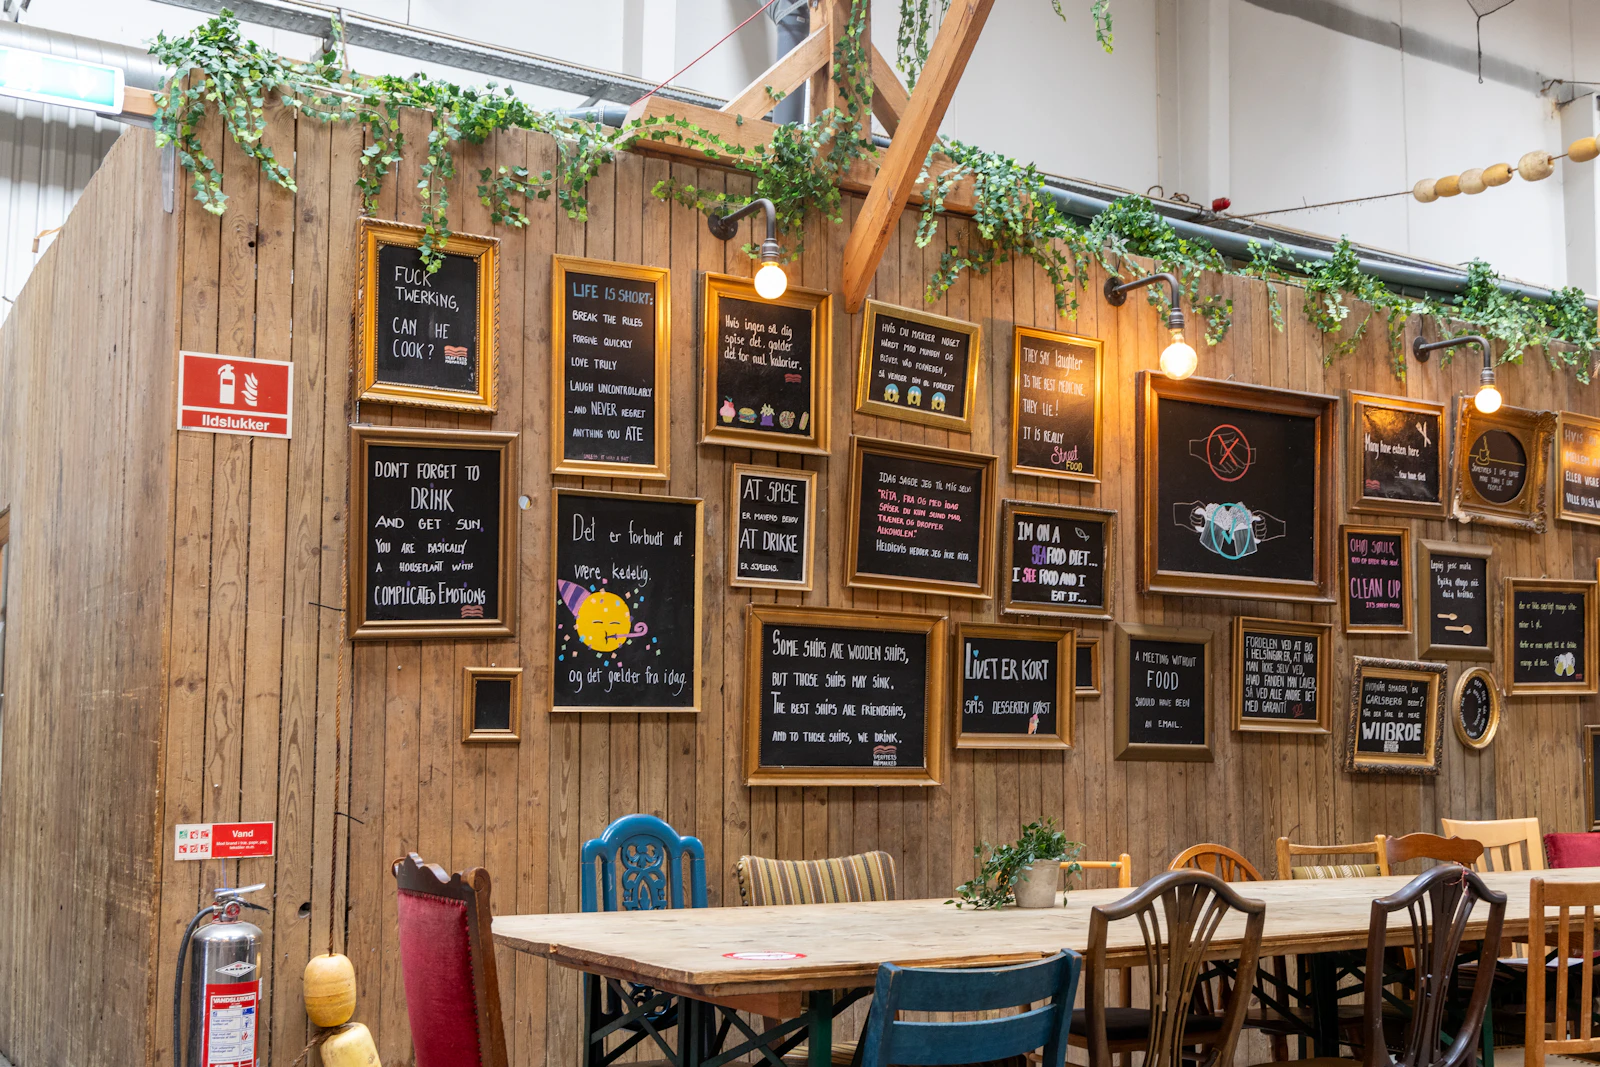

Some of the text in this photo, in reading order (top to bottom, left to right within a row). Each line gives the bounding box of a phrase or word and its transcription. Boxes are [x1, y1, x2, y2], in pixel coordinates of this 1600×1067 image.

[395, 265, 431, 287] FUCK
[573, 281, 654, 306] LIFE IS SHORT:
[573, 310, 643, 327] BREAK THE RULES
[725, 314, 765, 337] Hvis ingen
[392, 317, 450, 339] CAN HE
[573, 334, 633, 349] FORGIVE QUICKLY
[725, 333, 745, 349] spise
[900, 327, 961, 347] DU MÆRKER NOGET
[392, 339, 425, 359] COOK
[881, 338, 954, 361] HÅRDT MOD MUNDEN OG
[571, 357, 617, 370] LOVE TRULY
[724, 346, 802, 371] det for kalorier.
[1023, 347, 1083, 376] THEY SAY laughter
[570, 379, 652, 398] LAUGH UNCONTROLLABLY
[933, 381, 955, 392] FORKERT
[1023, 373, 1056, 392] IS THE BEST
[591, 401, 646, 419] NEVER REGRET
[1022, 398, 1038, 414] THEY
[202, 413, 270, 431] Ildslukker
[573, 426, 643, 442] ANYTHING YOU ATE
[1023, 426, 1065, 444] IT REALLY
[375, 461, 480, 481] DON'T FORGET TO
[1065, 461, 1083, 472] FOOD
[879, 471, 932, 489] IDAG SAGDE JEG
[1565, 470, 1582, 484] ELLER
[743, 478, 799, 504] AT SPISE
[1566, 493, 1581, 506] VILLE
[903, 494, 942, 508] FRA OG MED
[742, 511, 799, 525] ER BEHOV
[903, 507, 945, 519] DU KUN SUND
[375, 515, 442, 530] AND GET
[573, 513, 683, 546] Det er forbudt at
[878, 514, 944, 531] TRÆNER OG DROPPER
[740, 528, 798, 553] AT DRIKKE
[1036, 523, 1060, 544] ON A
[401, 542, 416, 554] ARE
[931, 549, 942, 558] JEG
[376, 560, 444, 572] A HOUSEPLANT
[740, 562, 749, 570] ER
[612, 562, 651, 588] kedelig.
[1012, 567, 1086, 587] I SEE FOOD AND I
[1051, 590, 1067, 602] EAT
[1350, 577, 1401, 599] CLEAN UP
[772, 629, 881, 661] SOME ARE WOODEN
[1245, 636, 1313, 653] FORDELEN VED AT BO
[965, 642, 1049, 681] LIVET ER KORT
[1135, 651, 1197, 668] A MEETING WITHOUT
[1293, 651, 1301, 663] AT
[1245, 661, 1290, 674] MAN SELV
[568, 665, 659, 694] og det gælder fra
[771, 672, 868, 688] BUT THOSE MAY
[1147, 669, 1179, 691] FOOD
[1245, 674, 1298, 688] HVAD FANDEN MAN
[1245, 685, 1316, 702] SÅ VED ALLE ANDRE DET
[1411, 686, 1419, 694] EN
[770, 691, 857, 717] THE BEST ARE
[992, 700, 1051, 715] DESSERTEN FØRST
[1135, 696, 1190, 708] SHOULD HAVE BEEN
[1244, 700, 1259, 713] MED
[1365, 693, 1403, 706] CARLSBERG
[772, 731, 869, 743] AND TO THOSE WE
[1361, 721, 1422, 742] WIIBROE
[232, 829, 255, 838] Vand
